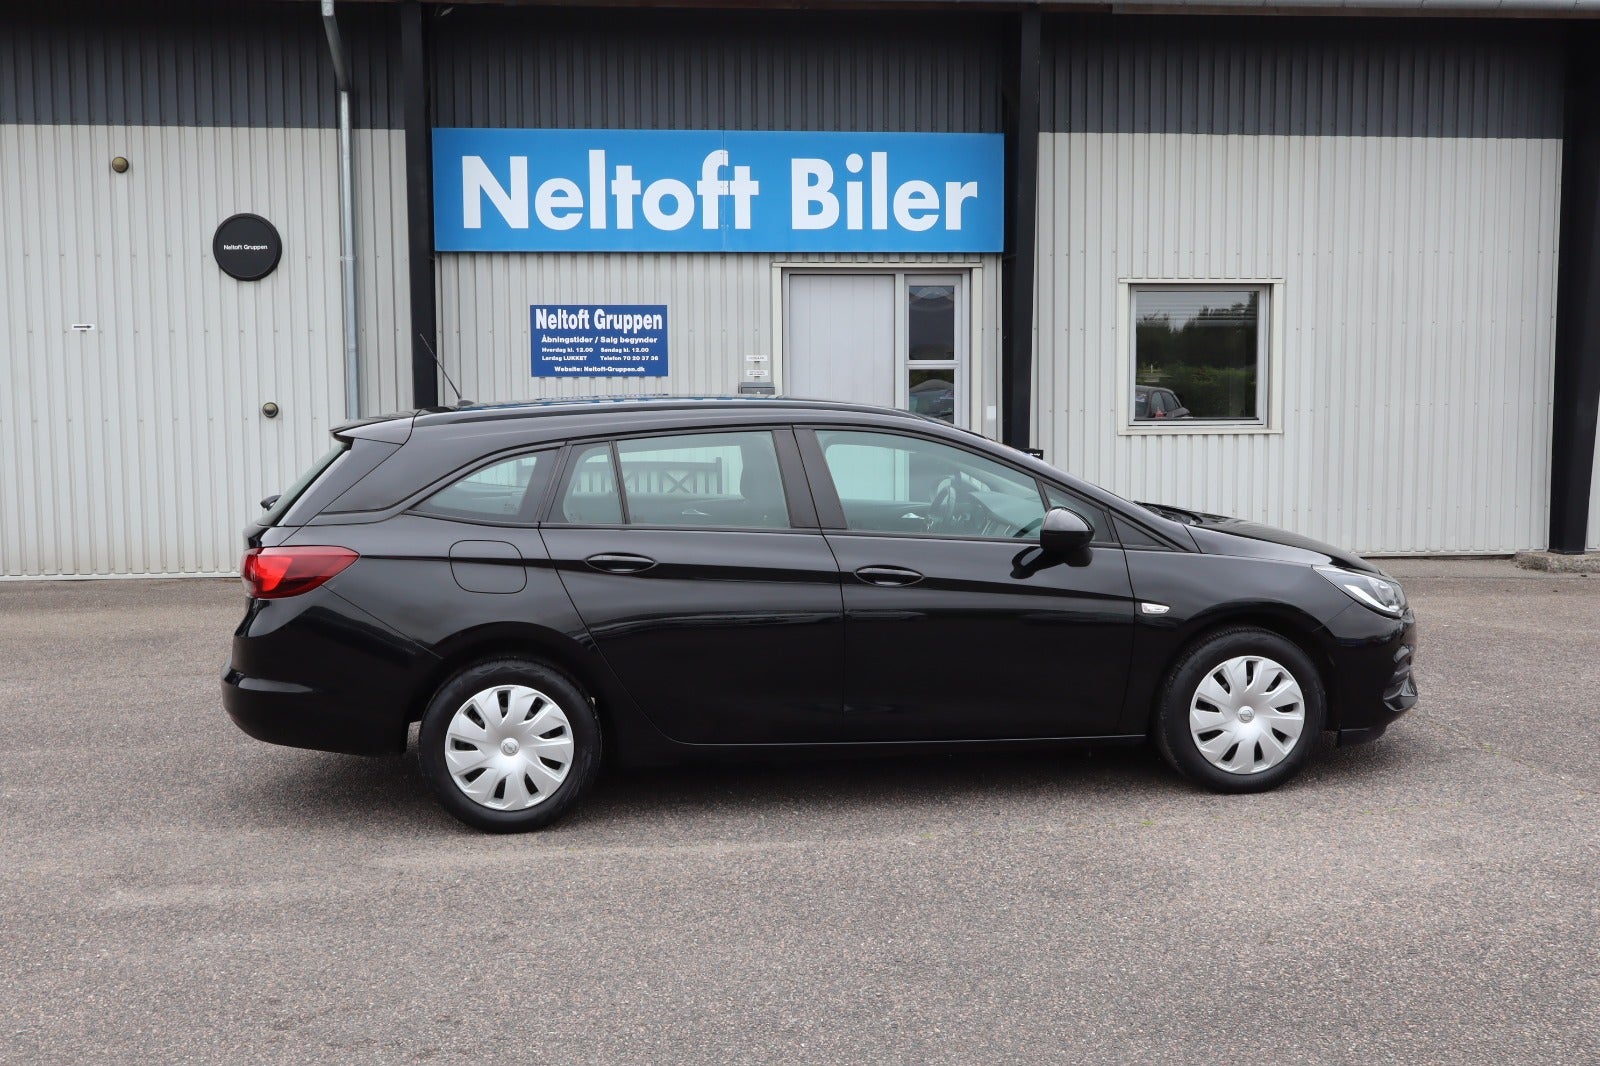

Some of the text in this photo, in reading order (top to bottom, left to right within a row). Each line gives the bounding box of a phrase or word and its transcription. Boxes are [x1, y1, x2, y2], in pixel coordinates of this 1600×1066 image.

[462, 149, 978, 232] Neltoft Biler
[535, 308, 663, 334] Neltoft Gruppen
[541, 334, 593, 344] Åbningstider
[600, 336, 618, 344] Salg
[619, 336, 658, 344] begynder
